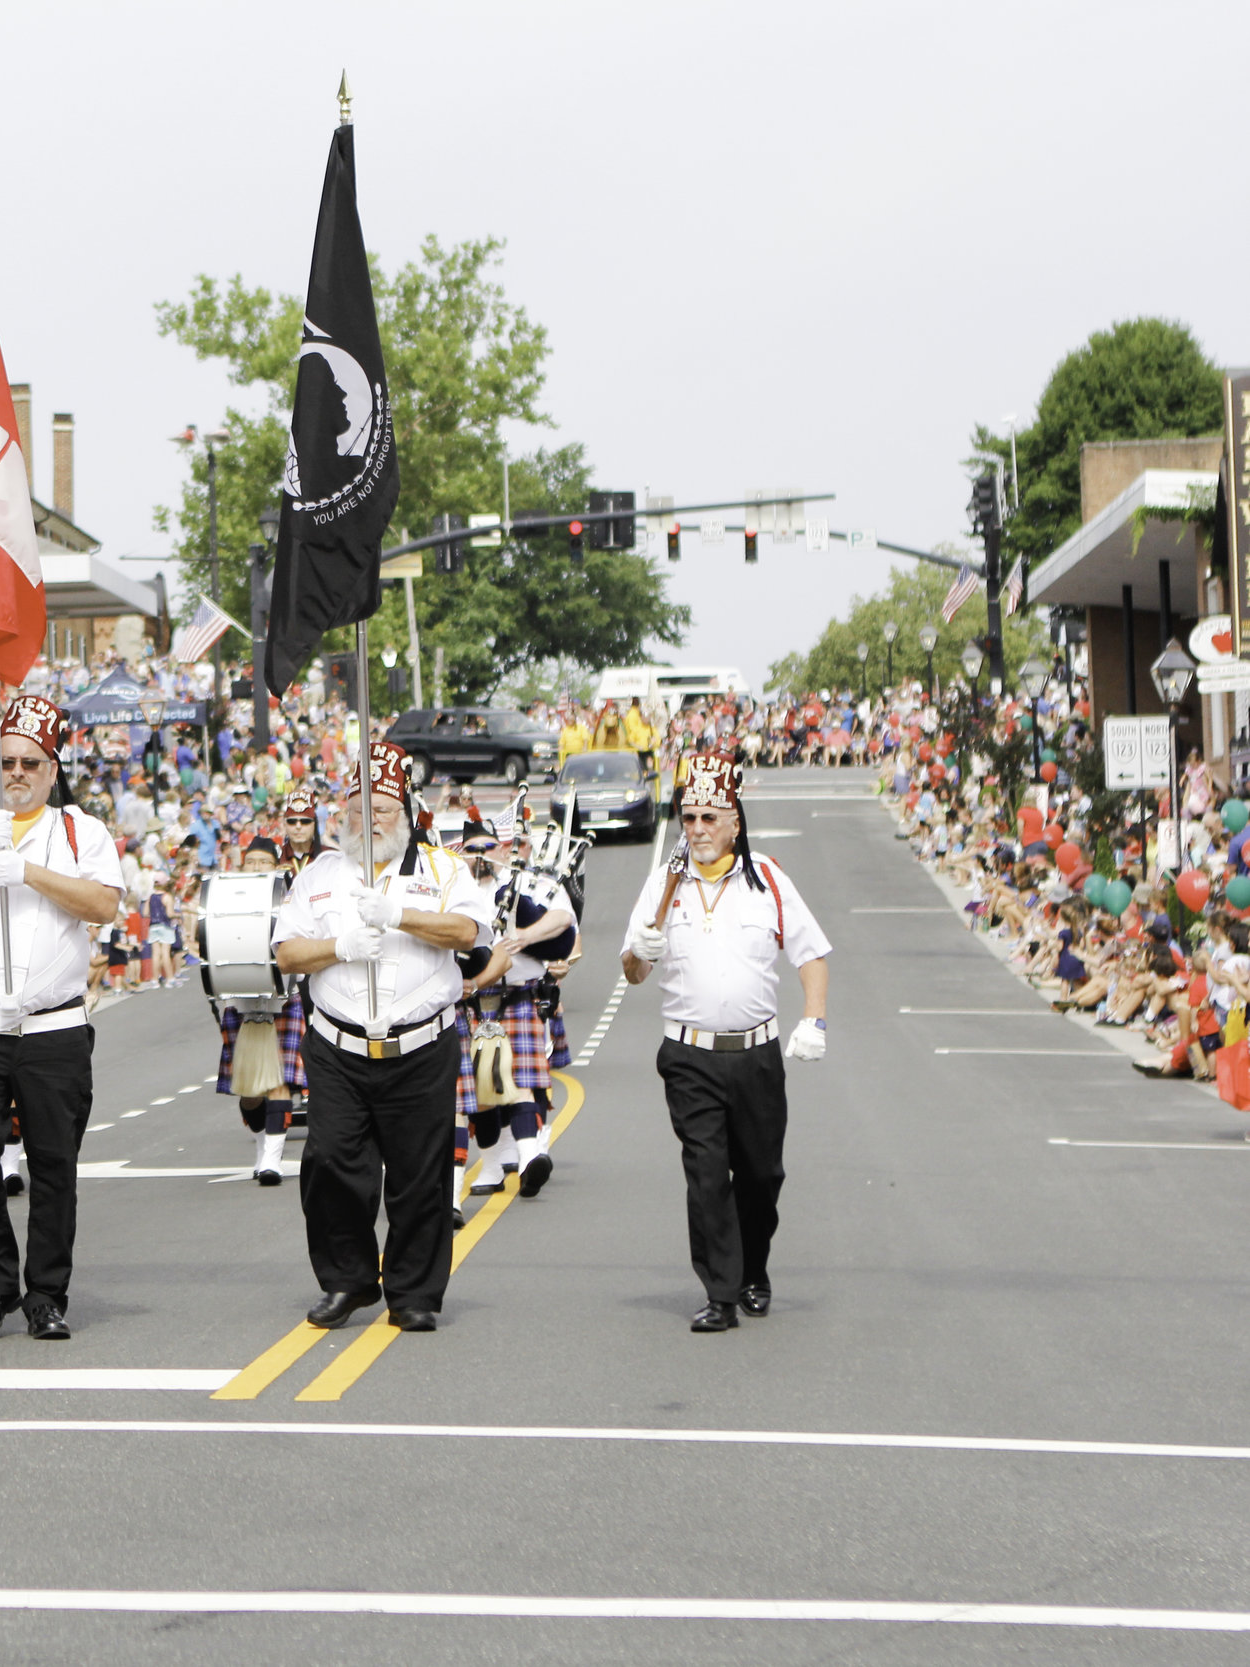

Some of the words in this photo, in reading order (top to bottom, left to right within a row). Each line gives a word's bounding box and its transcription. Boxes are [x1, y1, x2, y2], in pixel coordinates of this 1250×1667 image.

[313, 511, 335, 526] YOU
[337, 496, 358, 517] ARE
[357, 477, 375, 501] NOT
[372, 401, 391, 478] FORGOTTEN
[8, 697, 57, 735] KENA
[84, 712, 108, 724] Live
[110, 710, 132, 722] Life
[6, 727, 43, 744] RECORDER
[1111, 725, 1137, 736] SOUTH
[1117, 743, 1134, 757] 123
[1151, 742, 1167, 756] 123
[685, 756, 731, 790] KENA
[377, 784, 400, 798] HONOR
